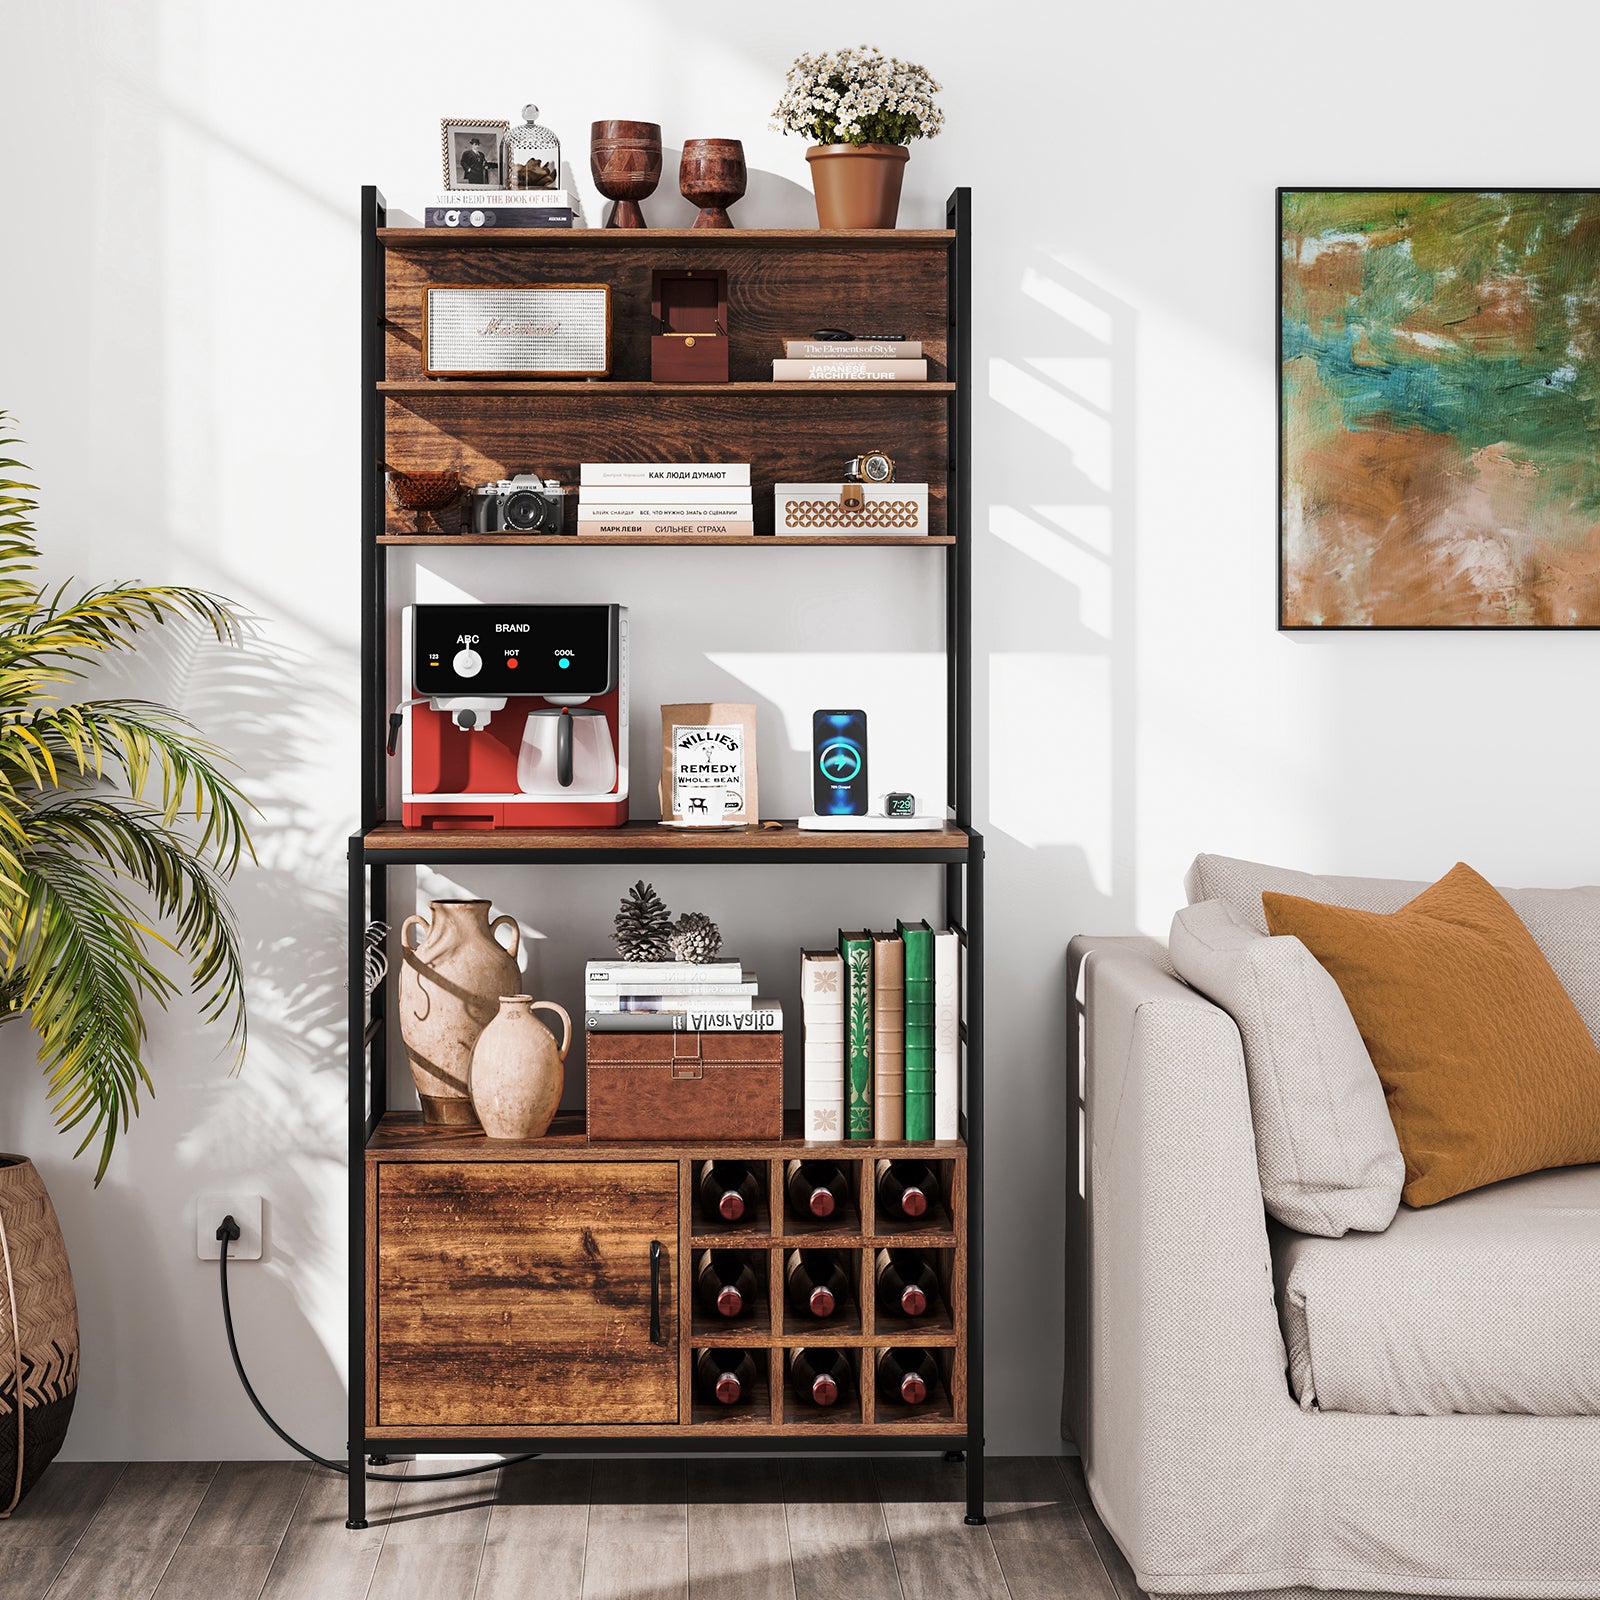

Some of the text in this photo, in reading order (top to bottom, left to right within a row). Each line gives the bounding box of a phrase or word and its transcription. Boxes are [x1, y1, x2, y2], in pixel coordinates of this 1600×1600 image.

[436, 195, 561, 204] MILES REDD THE BOOK OF CHIC
[804, 344, 897, 356] The Elements of Style
[808, 372, 896, 380] ARCHITECTURE
[666, 472, 691, 480] ЛЮДИ
[692, 472, 727, 480] ДУМАЮТ
[655, 525, 727, 533] СИЛЬНЕЕ СТРАХА
[495, 624, 530, 633] BRAND
[456, 634, 480, 644] ABC
[504, 649, 520, 657] HOT
[554, 649, 575, 657] COOL
[678, 731, 739, 752] WILLIE'S
[680, 764, 737, 773] REMEDY
[678, 776, 740, 784] WHOLE BEAN
[892, 800, 911, 809] 7:29
